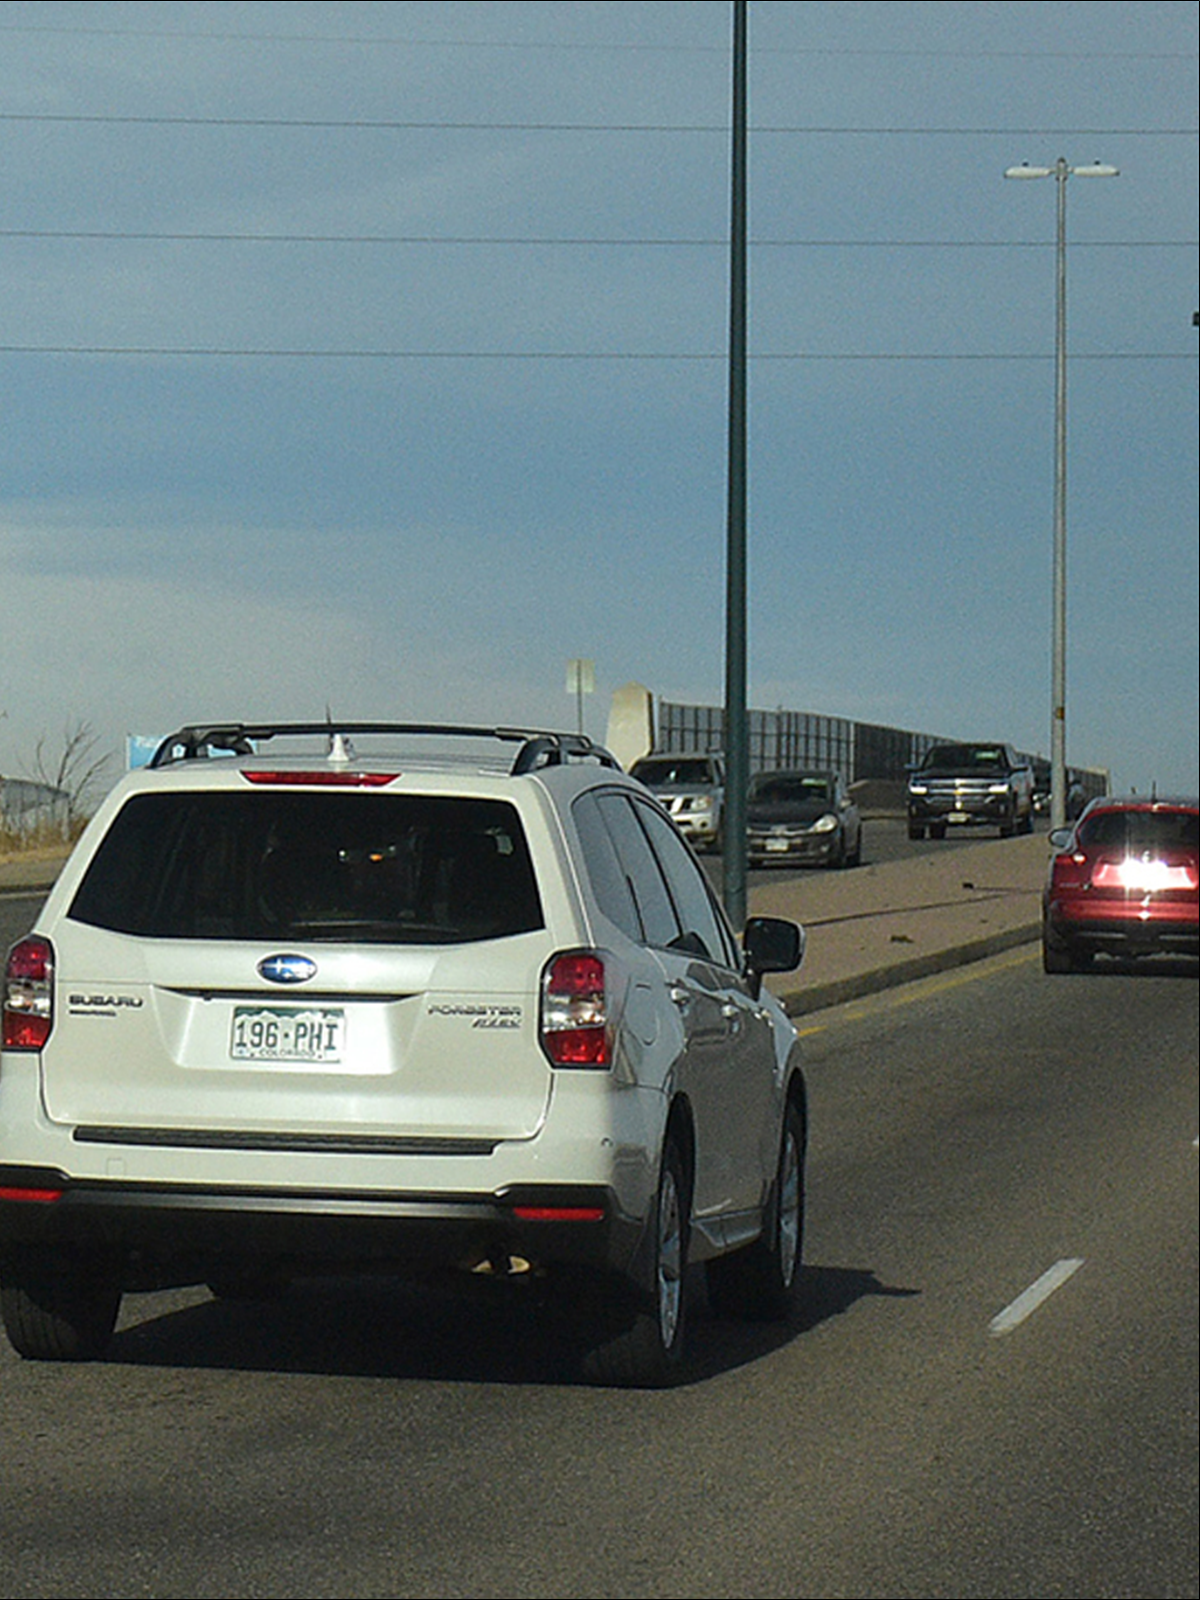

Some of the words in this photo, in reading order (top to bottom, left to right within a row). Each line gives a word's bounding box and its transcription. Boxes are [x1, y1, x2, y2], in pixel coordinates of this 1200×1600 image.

[69, 994, 143, 1007] SUBARU
[427, 1004, 521, 1016] FORESTER
[259, 1048, 316, 1057] COLORADO
